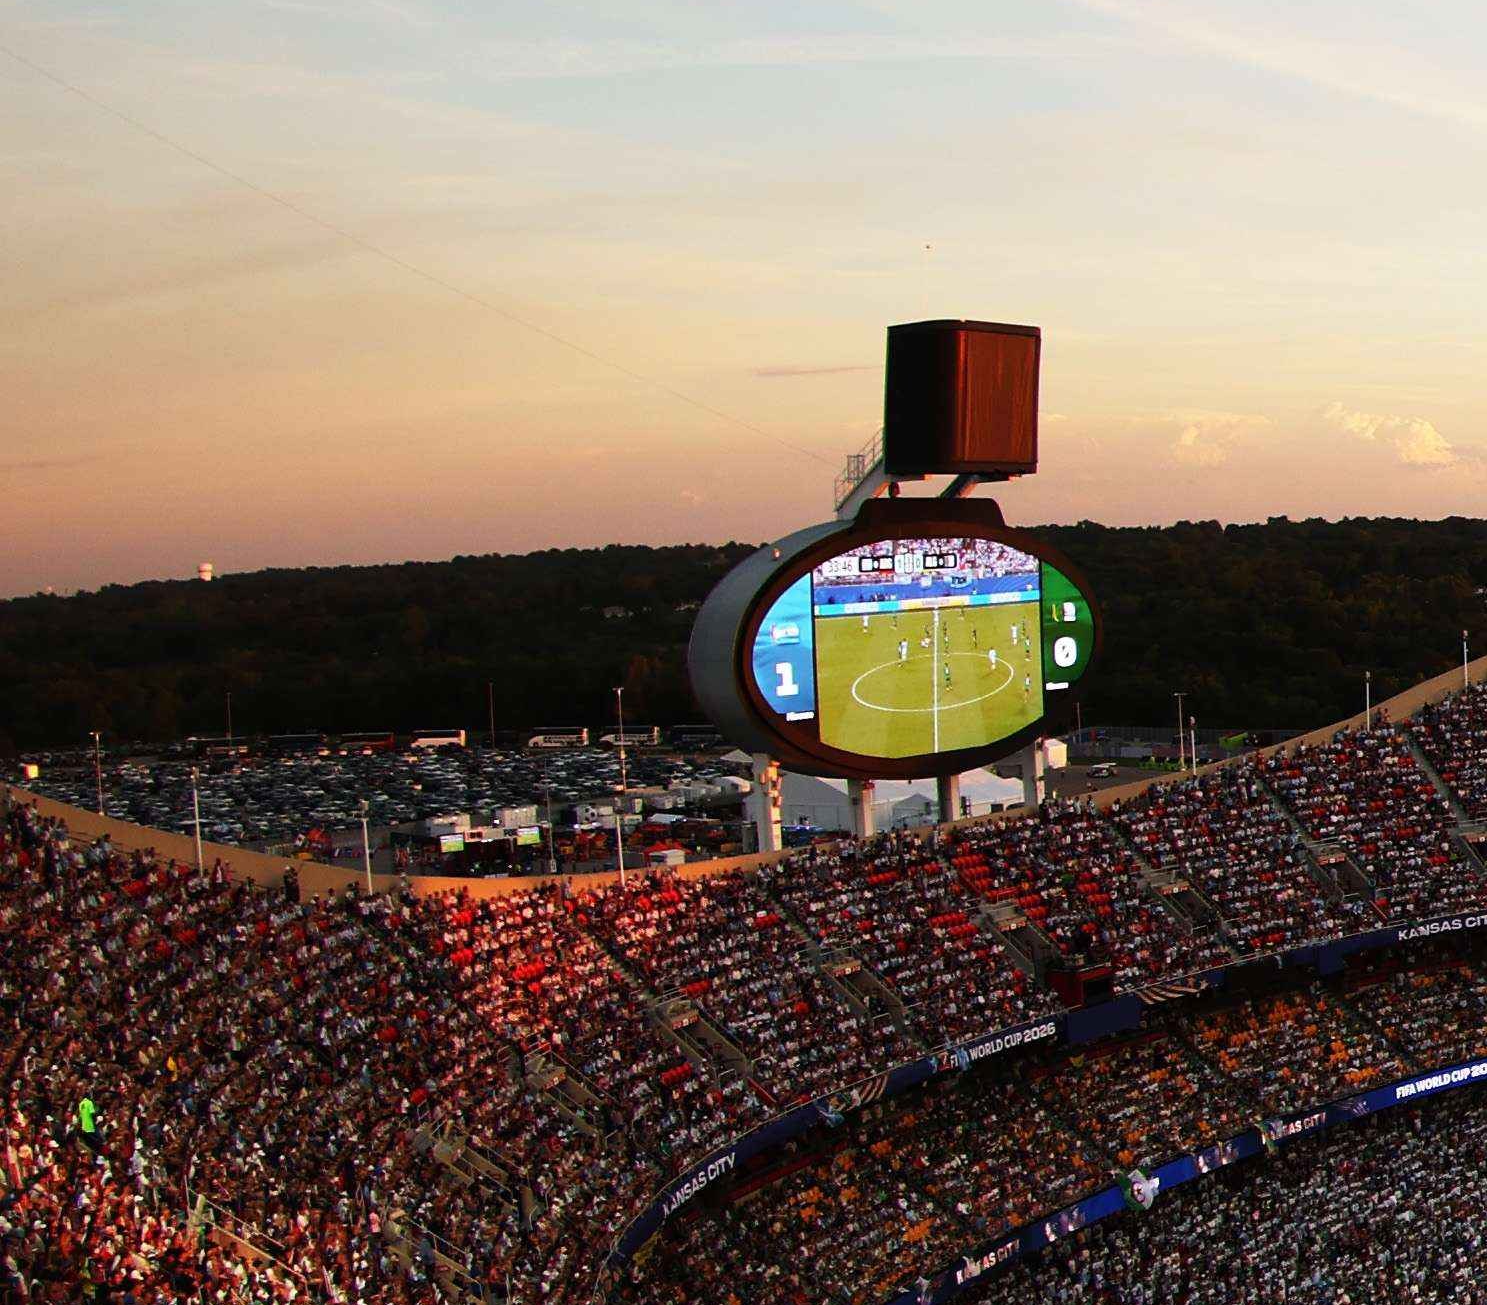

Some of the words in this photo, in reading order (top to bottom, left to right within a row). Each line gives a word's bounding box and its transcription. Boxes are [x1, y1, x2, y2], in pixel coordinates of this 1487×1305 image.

[1053, 636, 1078, 668] 0
[775, 661, 799, 696] 1
[1398, 920, 1462, 941] KANSAS
[969, 1038, 1004, 1062] WORLD
[1004, 1032, 1023, 1048] CUP
[1023, 1022, 1057, 1043] 2026
[1396, 1082, 1417, 1099] FIFA
[1417, 1073, 1451, 1093] WORLD
[1451, 1068, 1471, 1084] CUP
[663, 1170, 709, 1217] KANSAS
[707, 1152, 736, 1181] CITY
